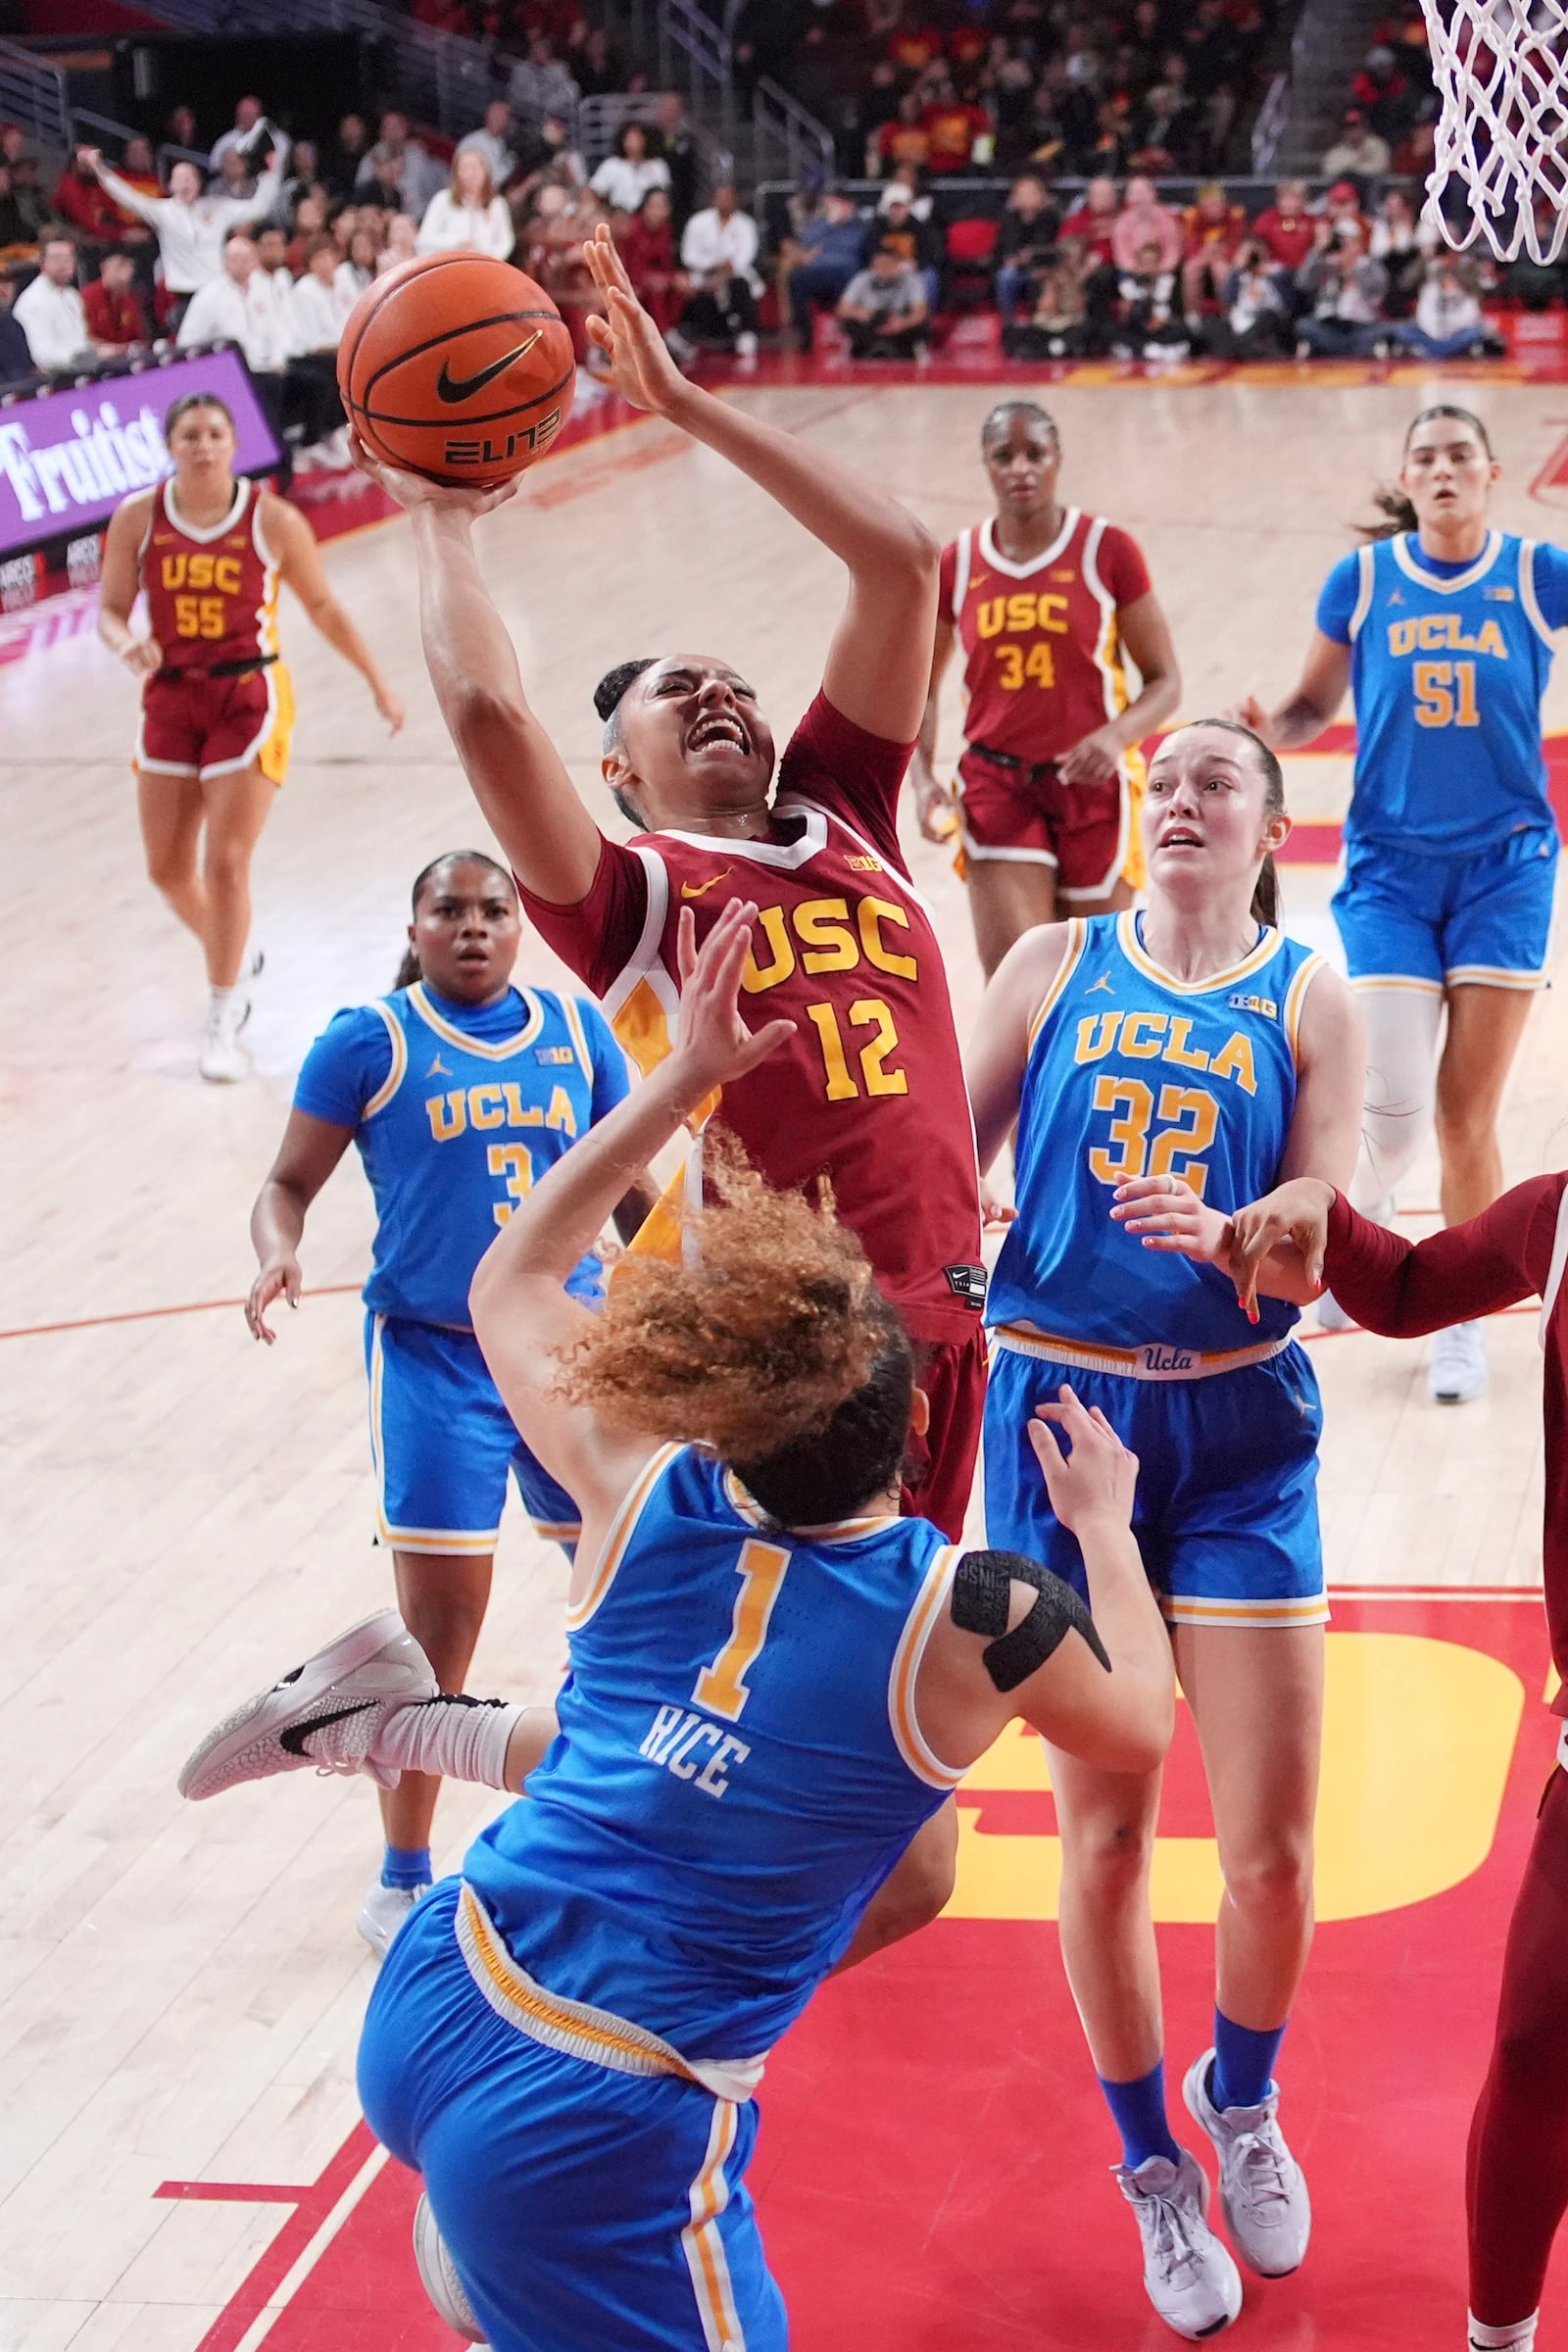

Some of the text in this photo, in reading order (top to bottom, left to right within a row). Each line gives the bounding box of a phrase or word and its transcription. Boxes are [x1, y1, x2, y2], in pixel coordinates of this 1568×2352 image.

[445, 407, 561, 464] ELITE
[162, 554, 242, 594] USC
[175, 596, 224, 639] 55
[977, 593, 1068, 638] USC
[1388, 614, 1508, 661] UCLA
[995, 642, 1054, 690] 34
[1413, 662, 1480, 727] 51
[742, 896, 918, 994] USC
[807, 999, 908, 1102] 12
[1074, 1011, 1257, 1097] UCLA
[425, 1082, 576, 1143] UCLA
[1089, 1075, 1220, 1200] 32
[487, 1143, 533, 1227] 3
[1145, 1348, 1193, 1370] Ucla
[690, 1537, 792, 1723] 1
[639, 1705, 751, 1798] RICE
